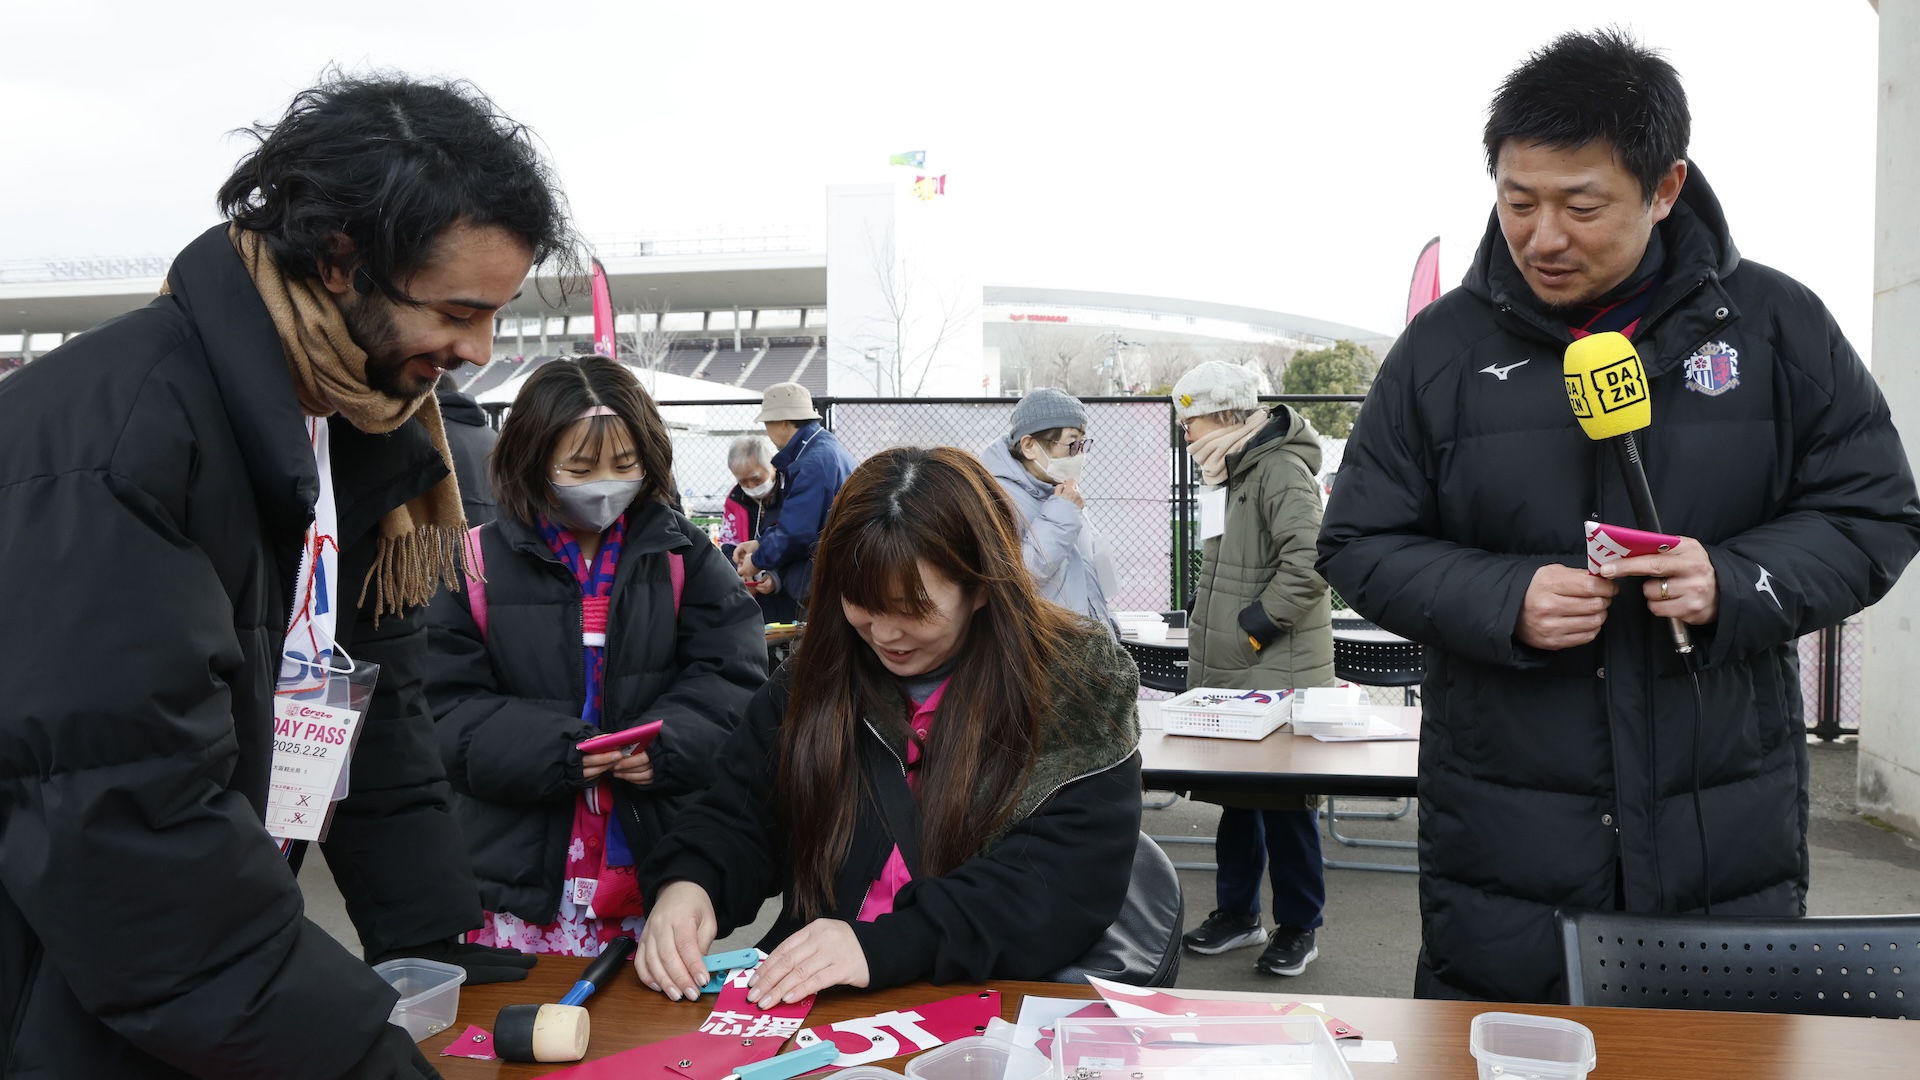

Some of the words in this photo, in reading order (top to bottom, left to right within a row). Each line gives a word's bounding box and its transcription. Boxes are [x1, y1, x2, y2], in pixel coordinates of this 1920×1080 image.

[1606, 367, 1633, 387] DA
[1611, 382, 1637, 403] ZN
[304, 723, 347, 745] PASS
[273, 740, 328, 758] 2025.2.22
[699, 1010, 803, 1038] 応援
